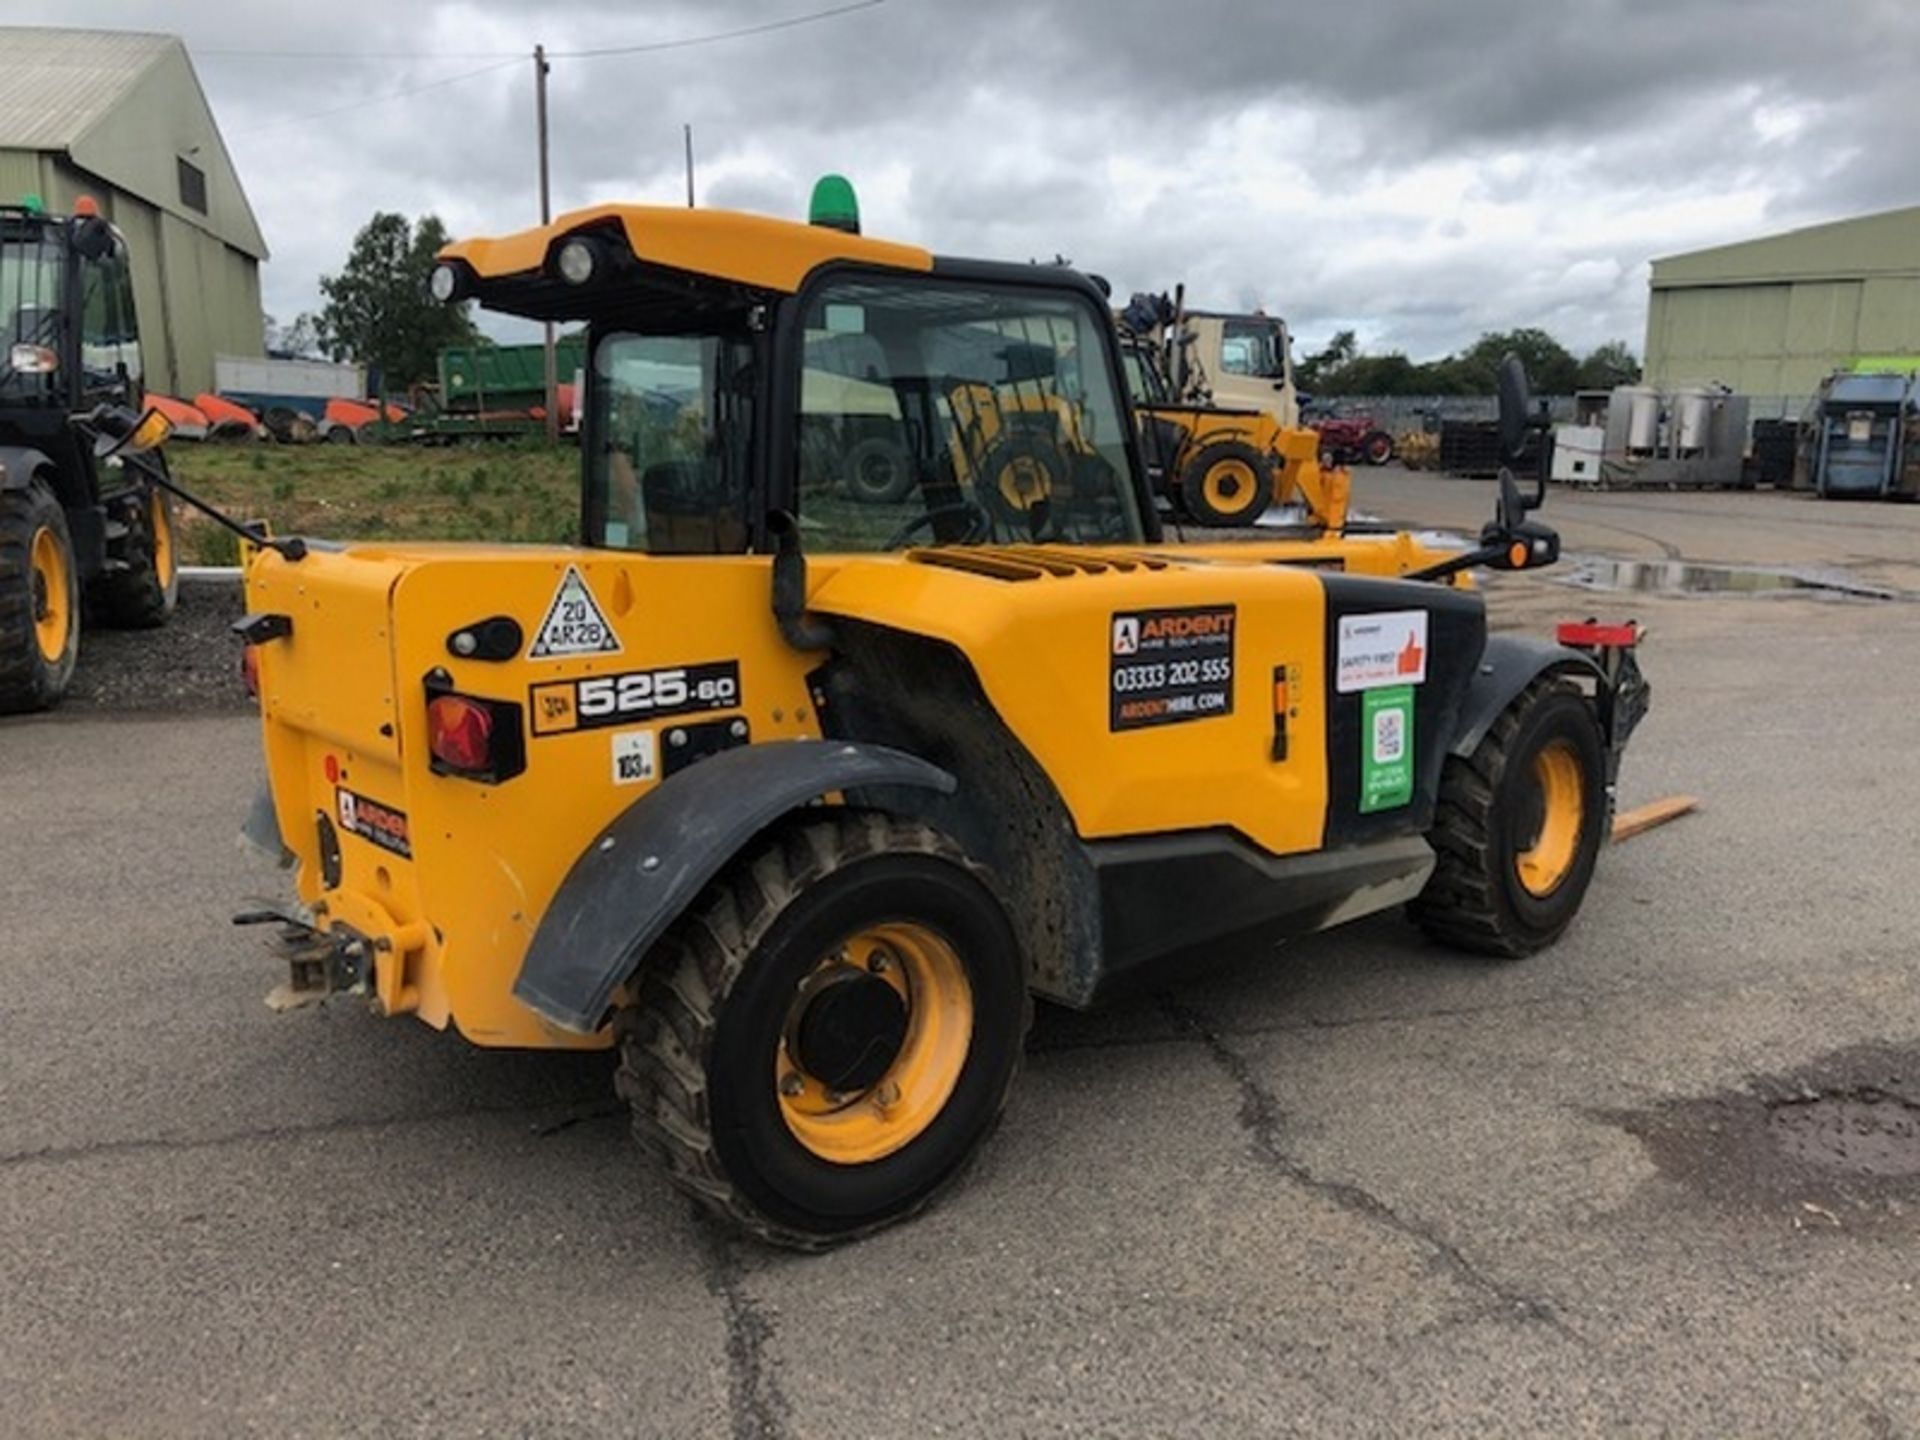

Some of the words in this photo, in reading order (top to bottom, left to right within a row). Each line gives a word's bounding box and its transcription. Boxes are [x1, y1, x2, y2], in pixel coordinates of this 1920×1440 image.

[563, 600, 586, 622] 20
[551, 623, 601, 645] AR28
[1141, 614, 1234, 638] ARDENT
[1113, 664, 1166, 692] 03333
[1168, 661, 1198, 685] 202
[1201, 657, 1231, 681] 555
